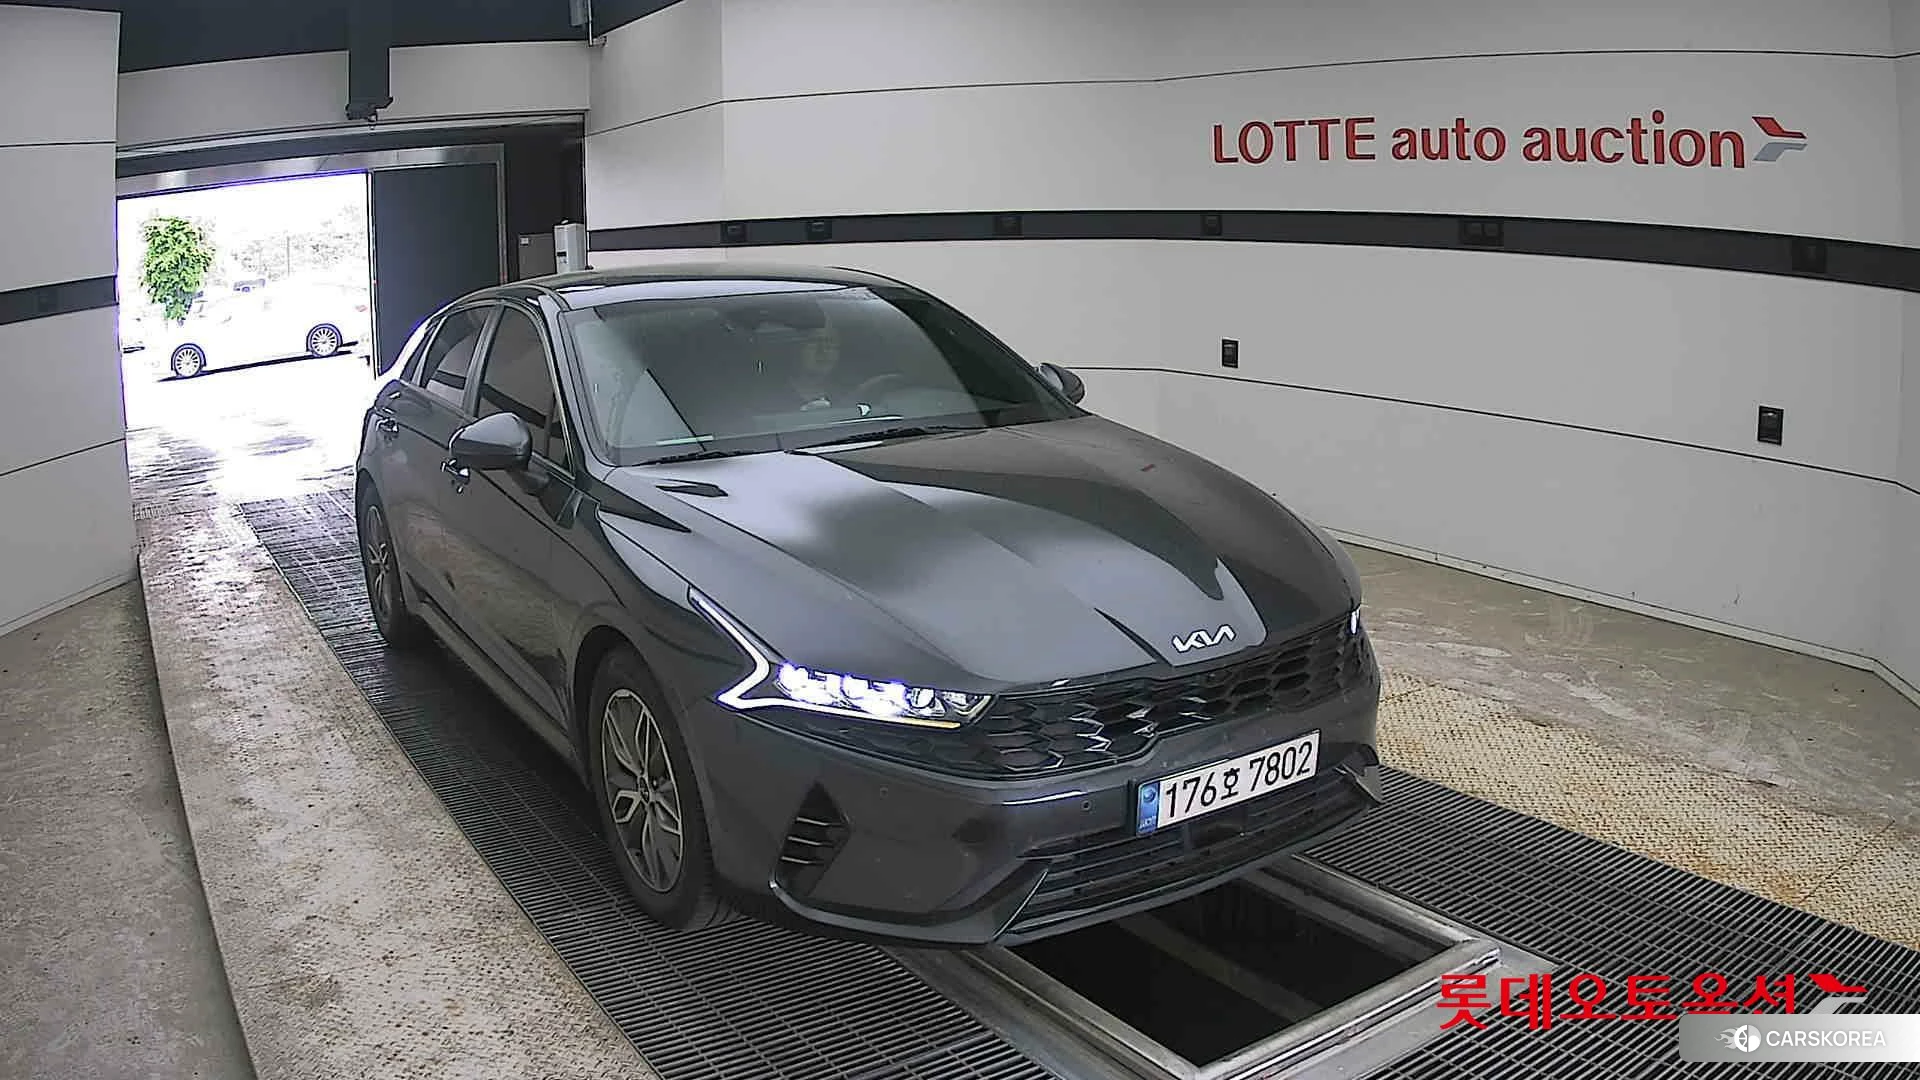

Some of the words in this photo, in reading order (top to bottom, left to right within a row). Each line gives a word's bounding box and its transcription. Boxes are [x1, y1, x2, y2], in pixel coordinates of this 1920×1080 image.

[1213, 116, 1376, 164] LOTTE
[1392, 117, 1506, 162] auto
[1522, 110, 1746, 169] auction
[1166, 767, 1240, 818] 176호
[1249, 741, 1313, 792] 7802
